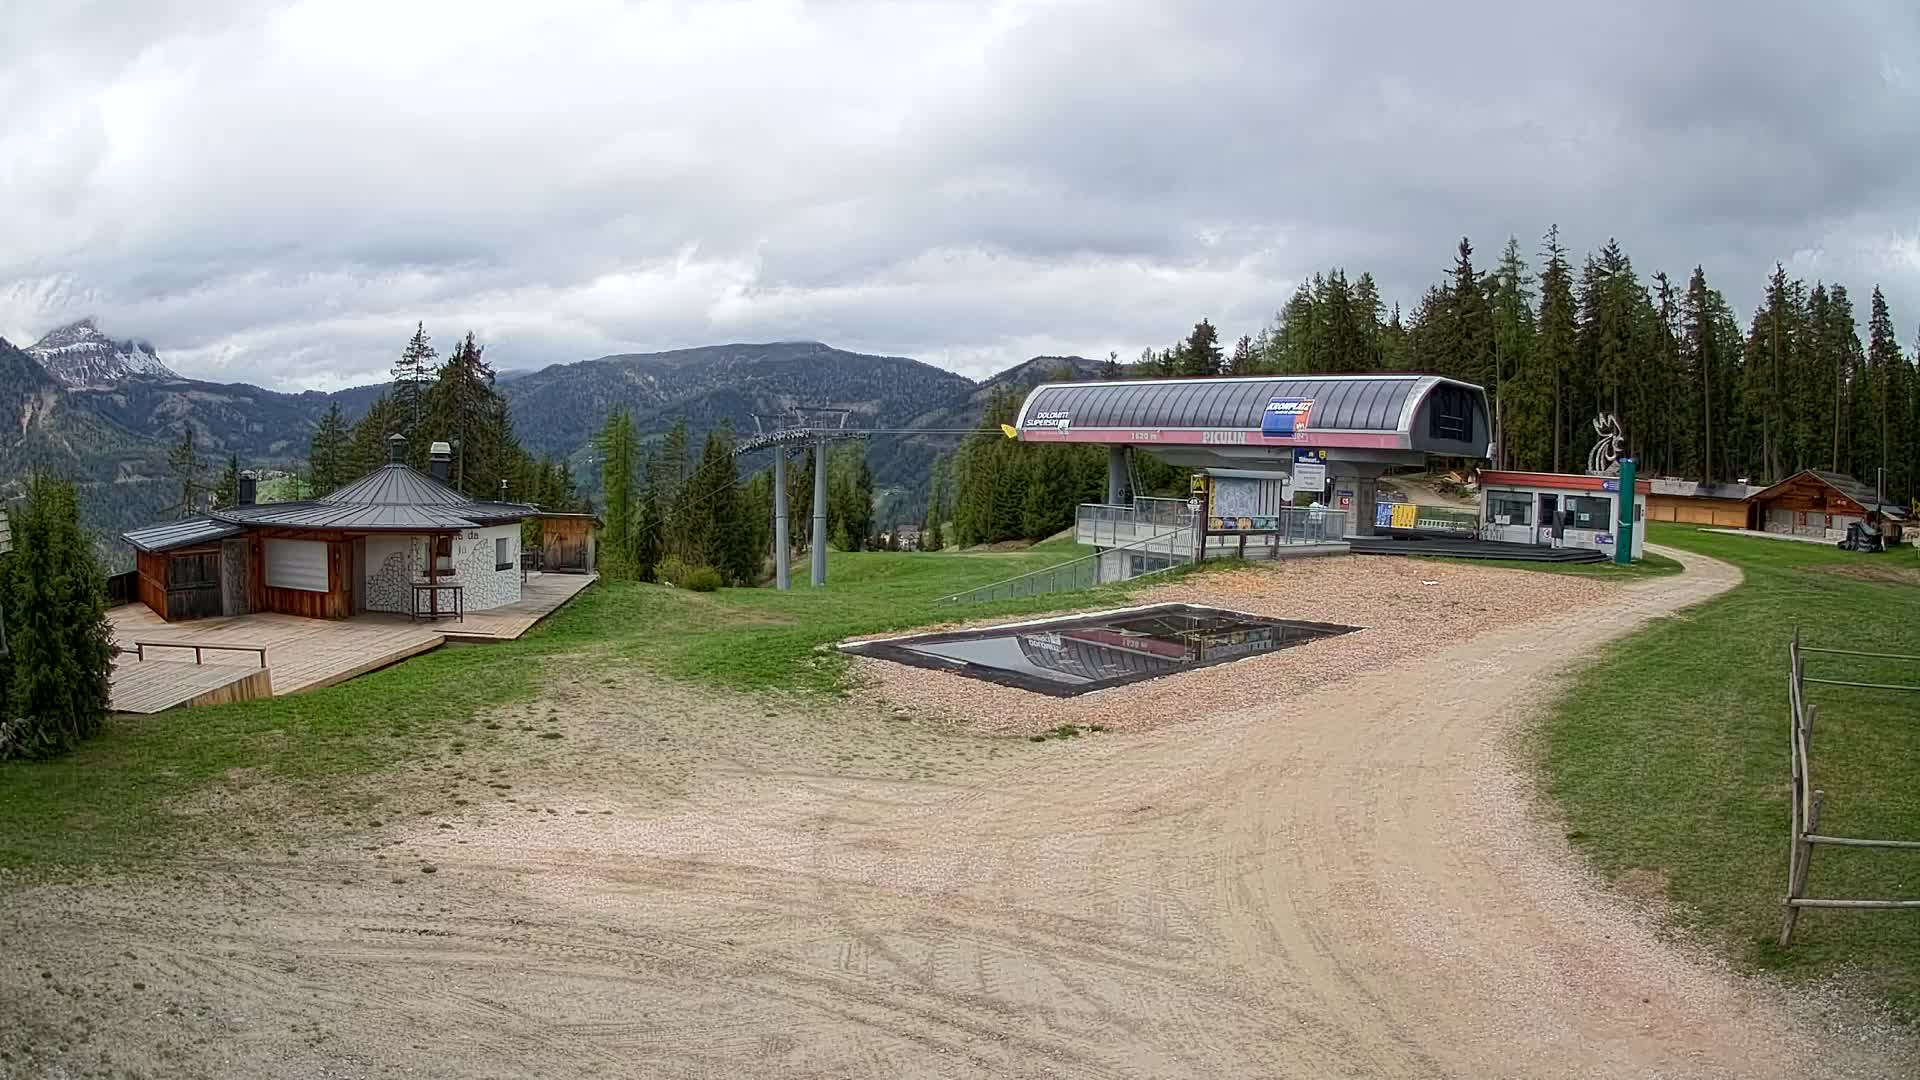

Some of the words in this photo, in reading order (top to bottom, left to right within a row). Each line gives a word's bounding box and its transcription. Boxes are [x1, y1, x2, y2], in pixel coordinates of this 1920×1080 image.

[1266, 402, 1312, 411] KRONPLATZ
[1037, 411, 1069, 419] DOLOMITI
[1202, 431, 1246, 444] PICULIN
